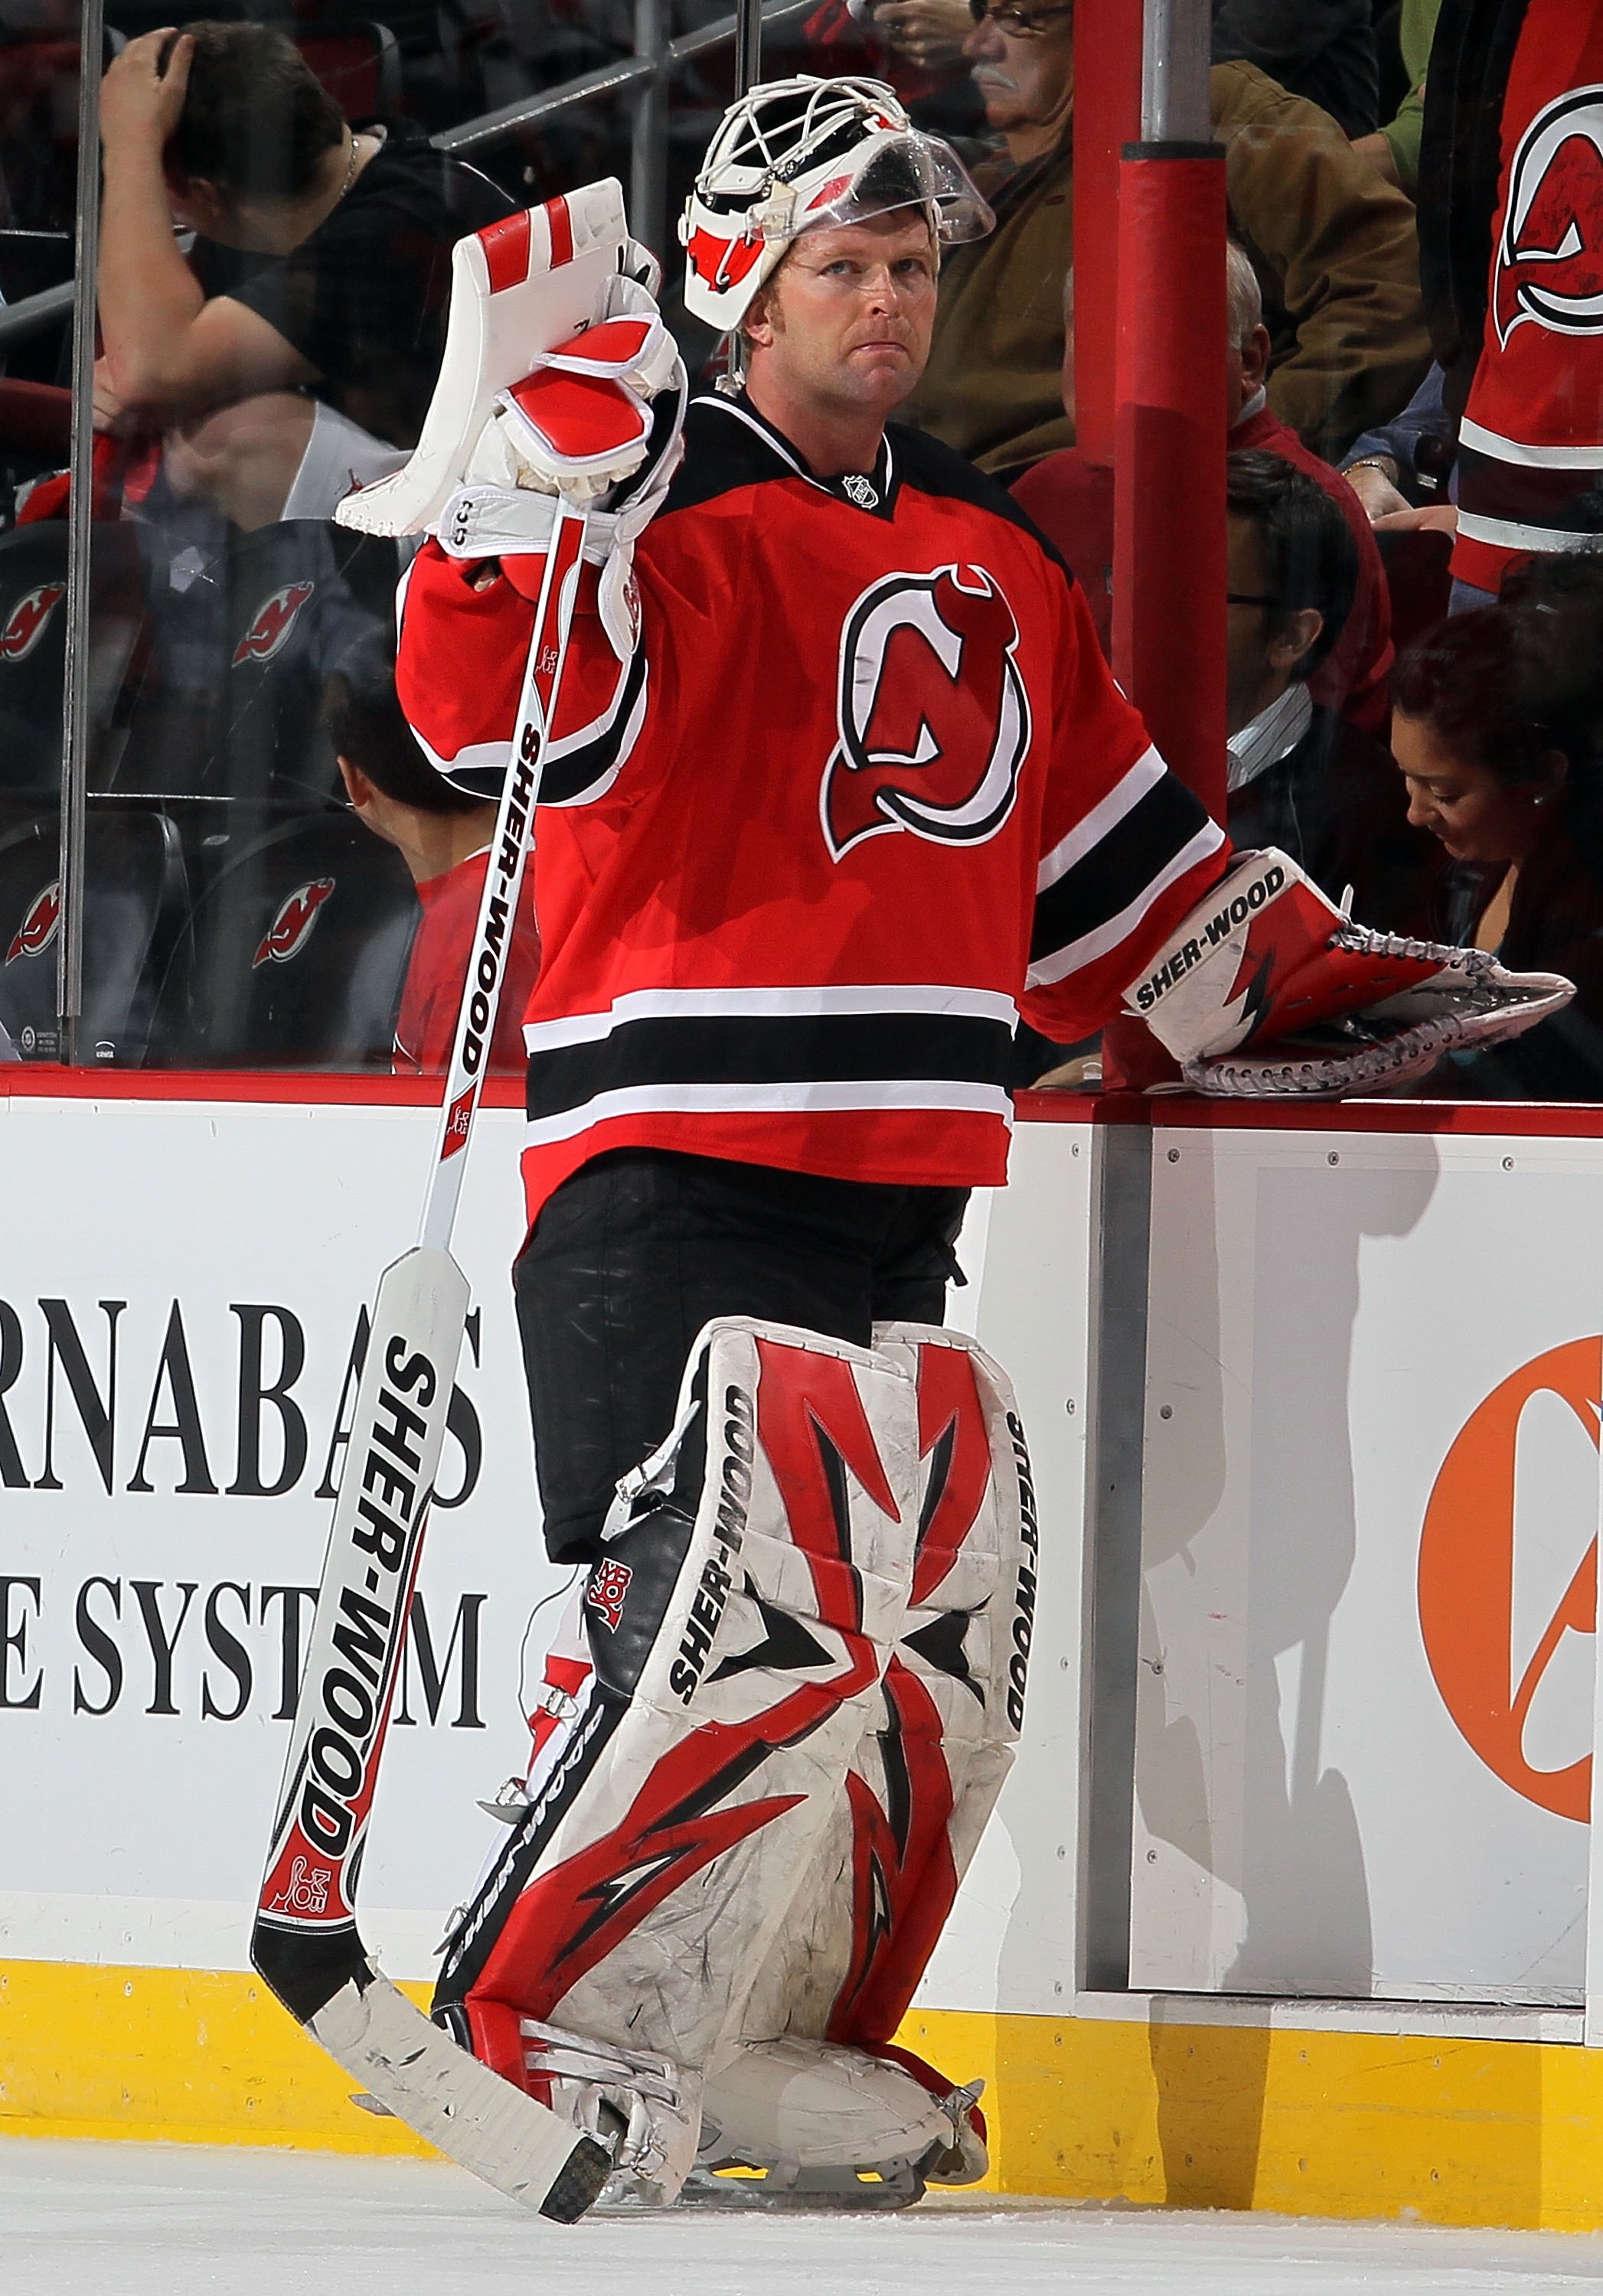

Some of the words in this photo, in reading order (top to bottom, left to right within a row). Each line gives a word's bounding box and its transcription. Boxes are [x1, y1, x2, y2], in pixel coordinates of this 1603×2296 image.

[462, 723, 540, 1075] SHER-WOOD
[1136, 866, 1285, 1010] SHER-WOOD
[73, 1576, 488, 1729] SYSTM
[301, 1336, 436, 1856] SHER-WOOD
[669, 1384, 755, 1705] SHER-WOOD
